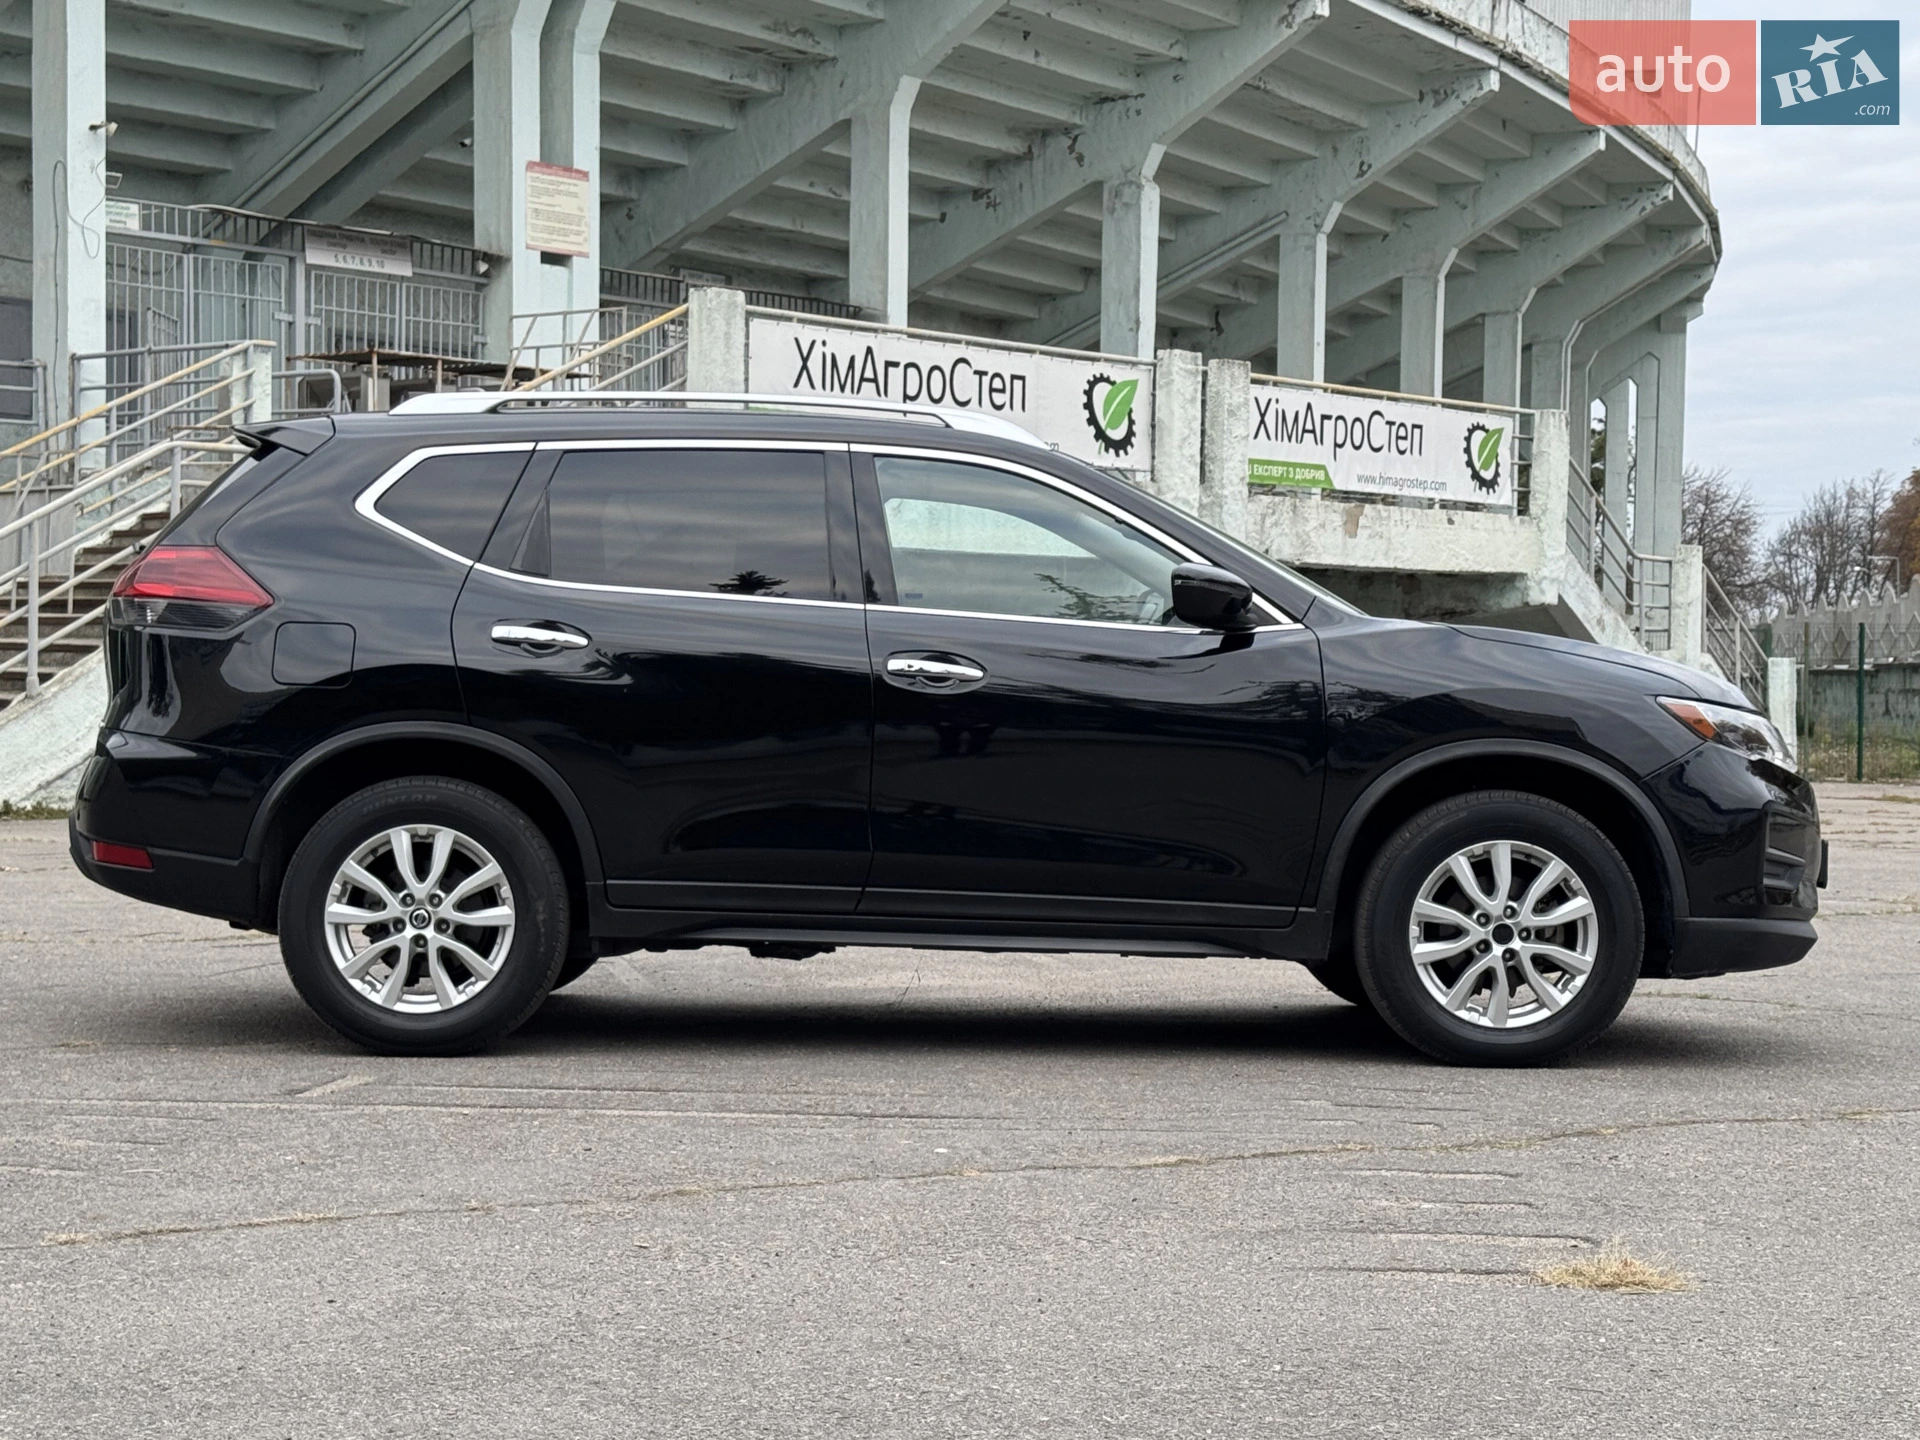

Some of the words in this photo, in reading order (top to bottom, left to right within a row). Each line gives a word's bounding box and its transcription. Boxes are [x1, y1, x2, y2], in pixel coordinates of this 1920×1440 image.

[793, 337, 1027, 417] ХімАгроСтеп
[1252, 395, 1424, 461] ХімАгроСтеп
[1253, 464, 1288, 478] ЕКСПЕРТ
[1295, 468, 1326, 481] ДОБРИВ
[1356, 471, 1447, 492] www.himagrostep.com
